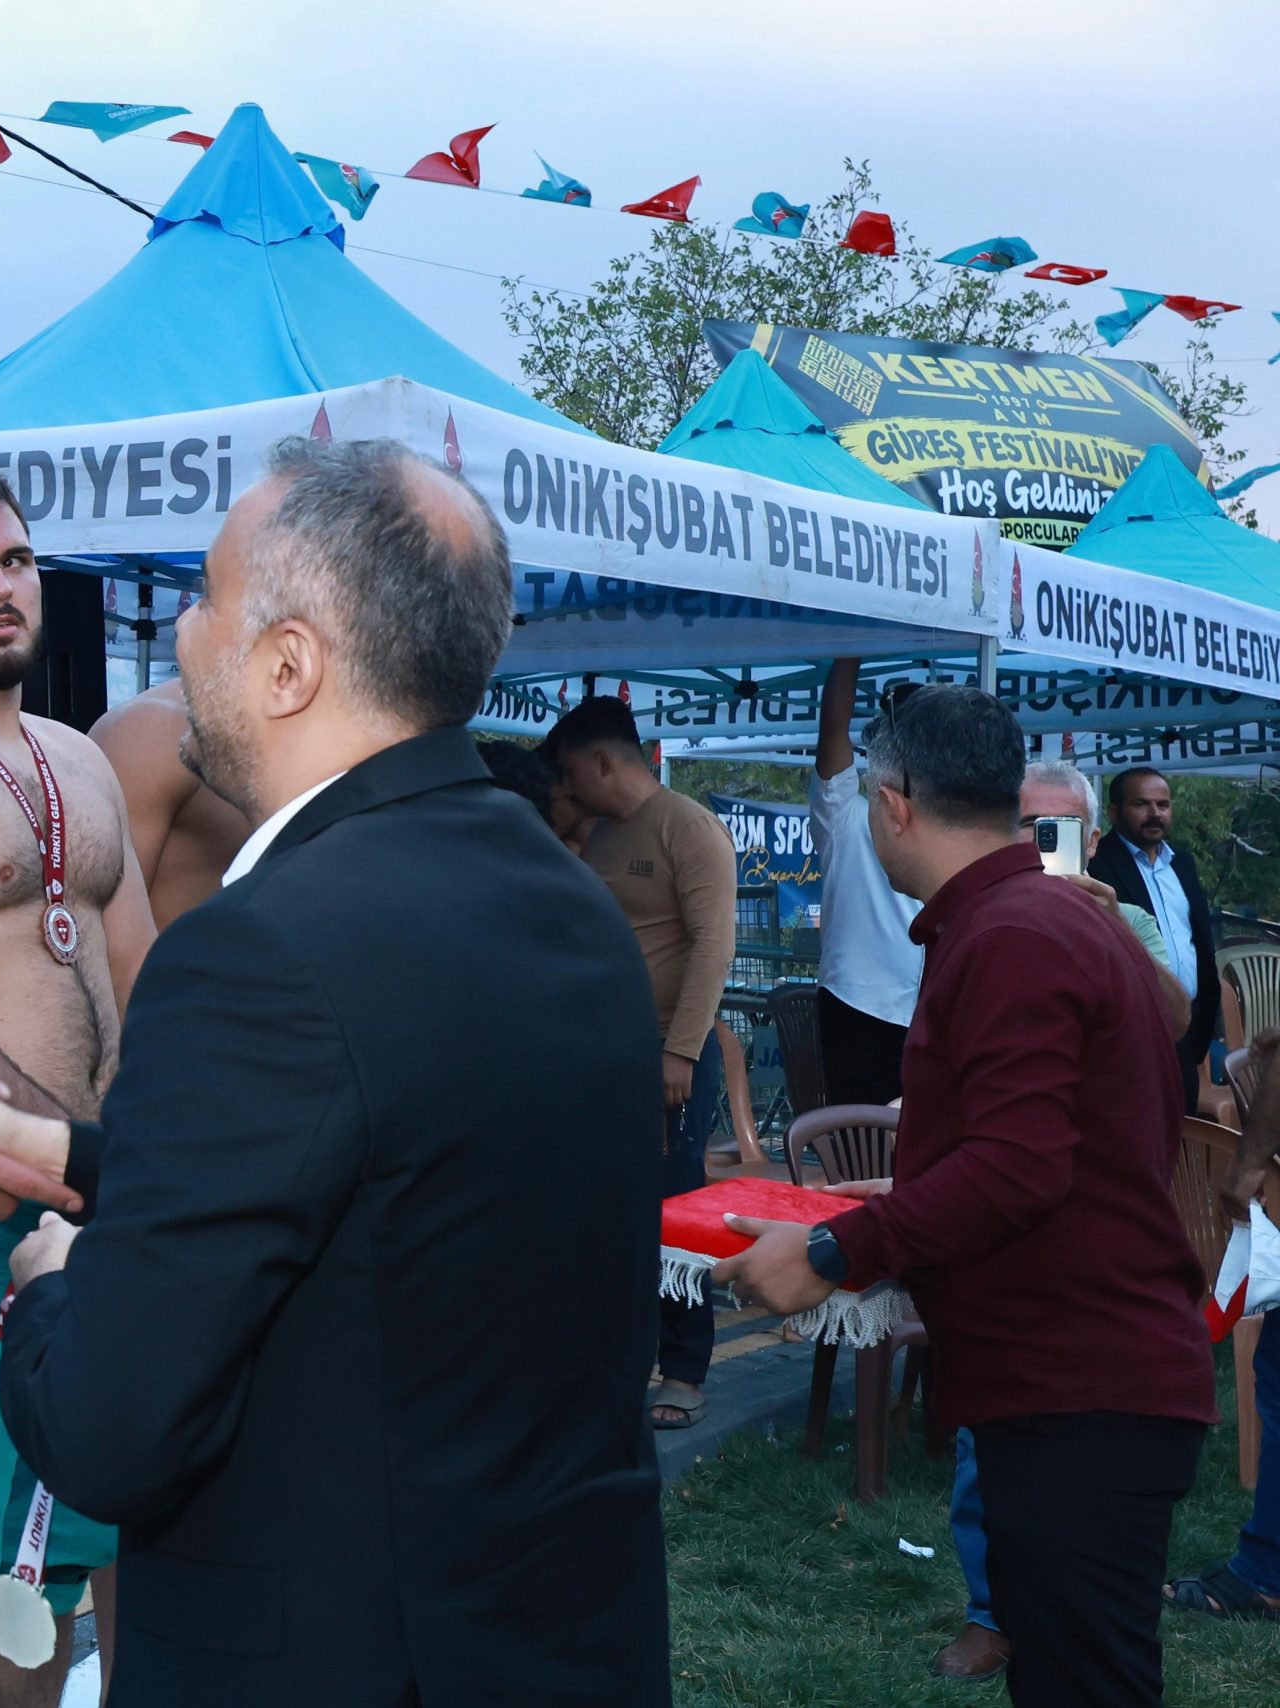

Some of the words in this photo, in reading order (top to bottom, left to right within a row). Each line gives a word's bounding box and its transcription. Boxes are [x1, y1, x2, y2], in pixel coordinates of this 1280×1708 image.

[868, 352, 1114, 403] KERTMEN
[991, 395, 1031, 408] 1997
[867, 423, 965, 466] GÜREŞ
[938, 468, 997, 516] Hoş
[503, 448, 756, 561] ONİKİŞUBAT
[762, 500, 949, 598] BELEDİYESİ
[1036, 580, 1188, 664] ONİKİŞUBAT
[51, 821, 61, 869] TÜRKİYE
[774, 816, 818, 855] SPO
